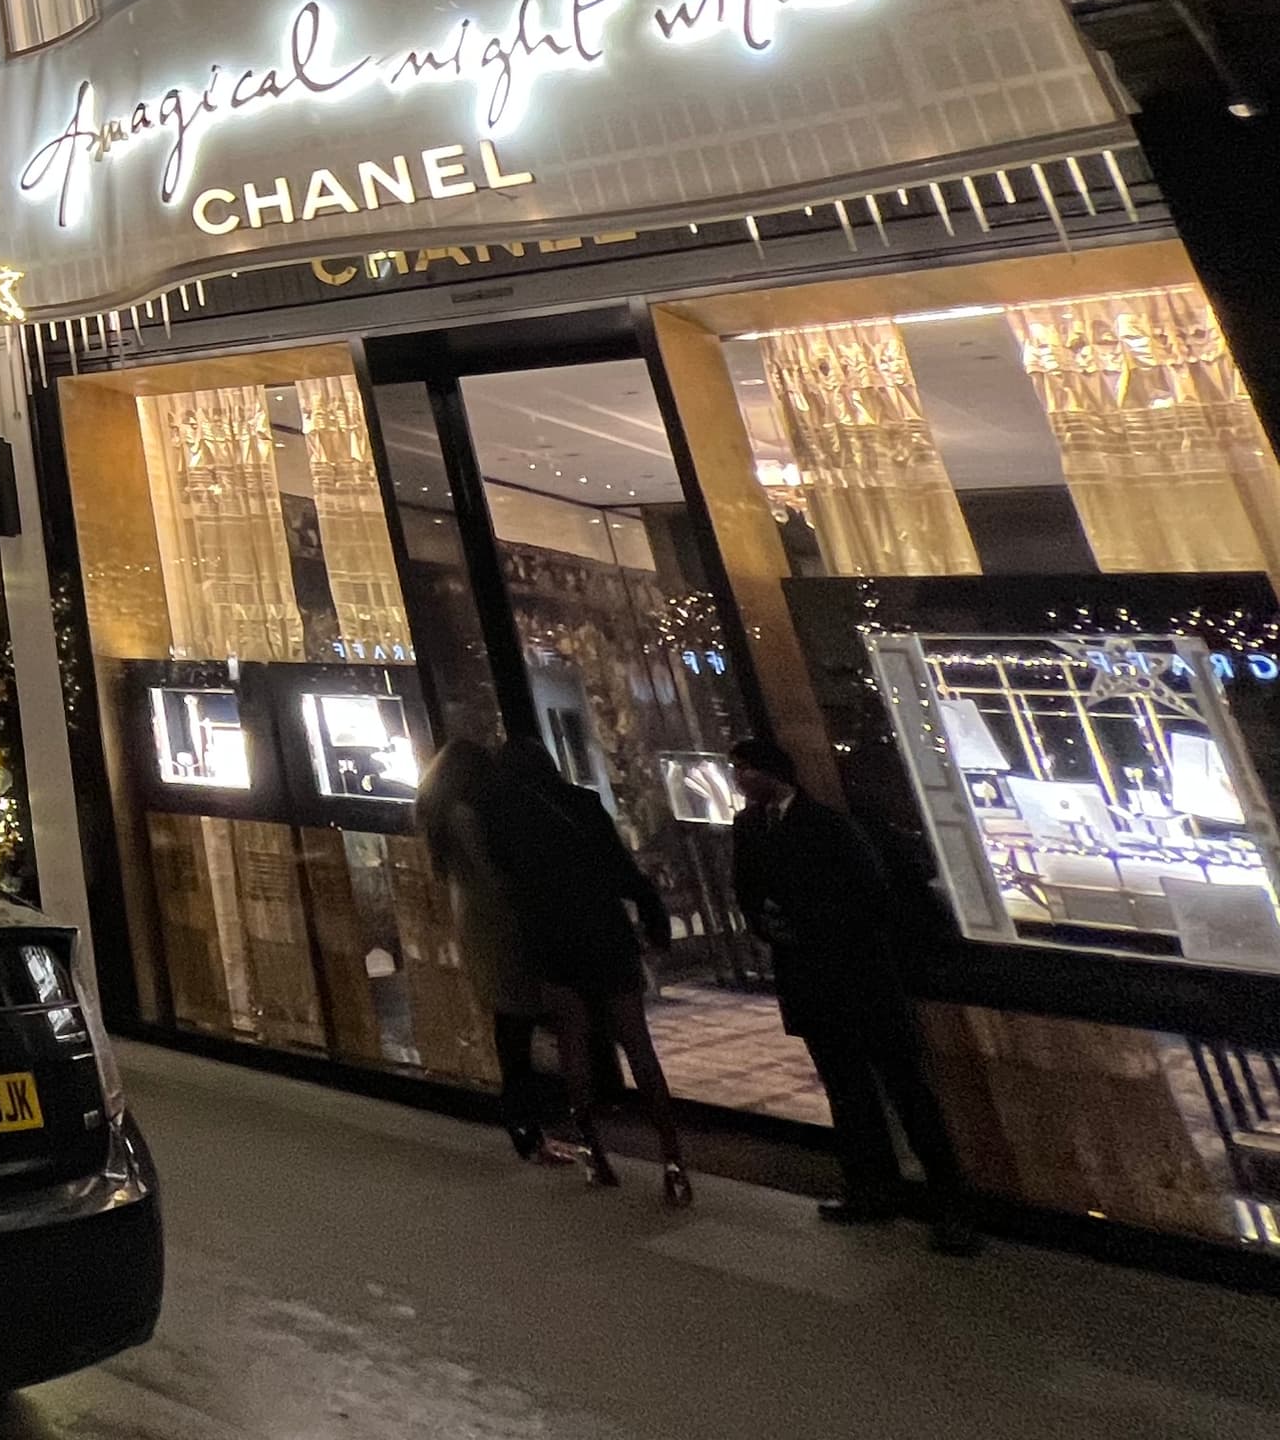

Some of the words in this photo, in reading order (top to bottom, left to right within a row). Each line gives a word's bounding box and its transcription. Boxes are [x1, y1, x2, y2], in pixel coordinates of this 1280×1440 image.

[85, 1, 372, 203] magical
[191, 138, 534, 236] CHANEL
[311, 230, 638, 287] CHA
